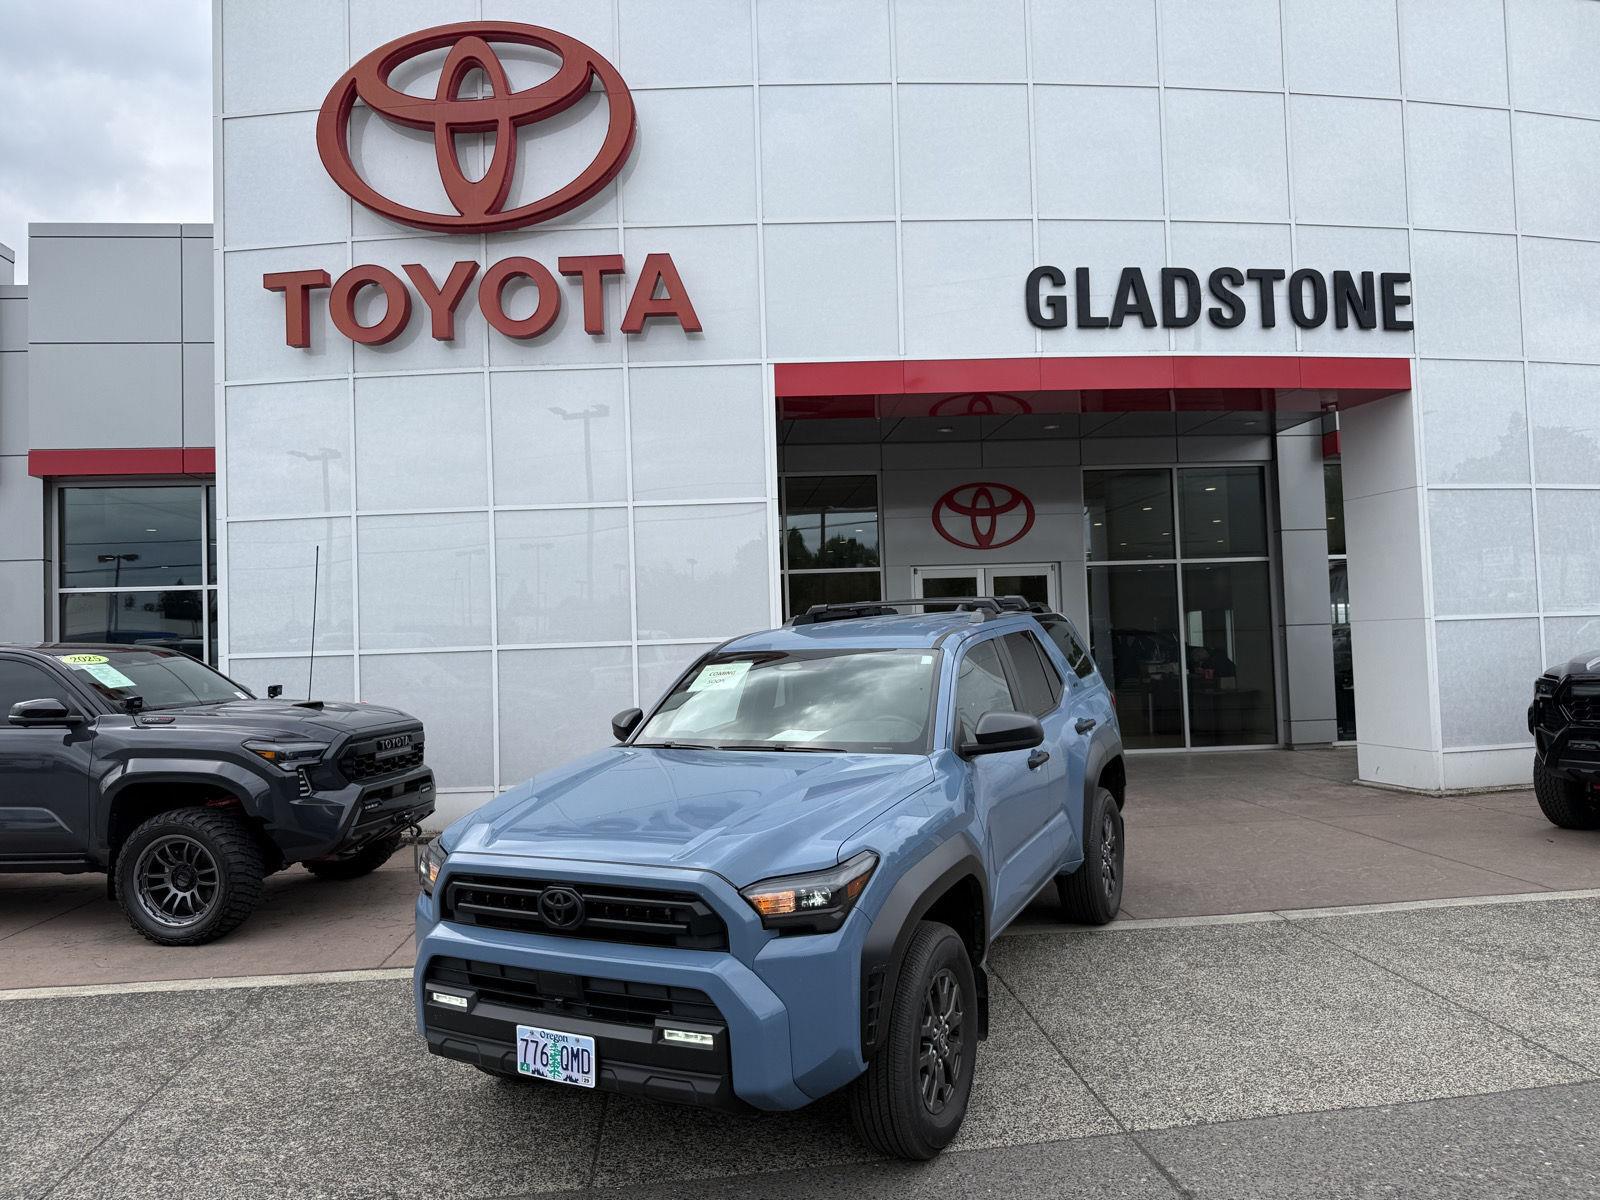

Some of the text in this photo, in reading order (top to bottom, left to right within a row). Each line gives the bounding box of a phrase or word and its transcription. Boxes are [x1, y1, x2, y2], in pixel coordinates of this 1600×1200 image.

[263, 253, 703, 349] TOYOTA
[1025, 265, 1414, 331] GLADSTONE
[381, 735, 410, 750] TOYOTA
[539, 1030, 569, 1043] Oregon
[520, 1037, 591, 1074] 776 QMD
